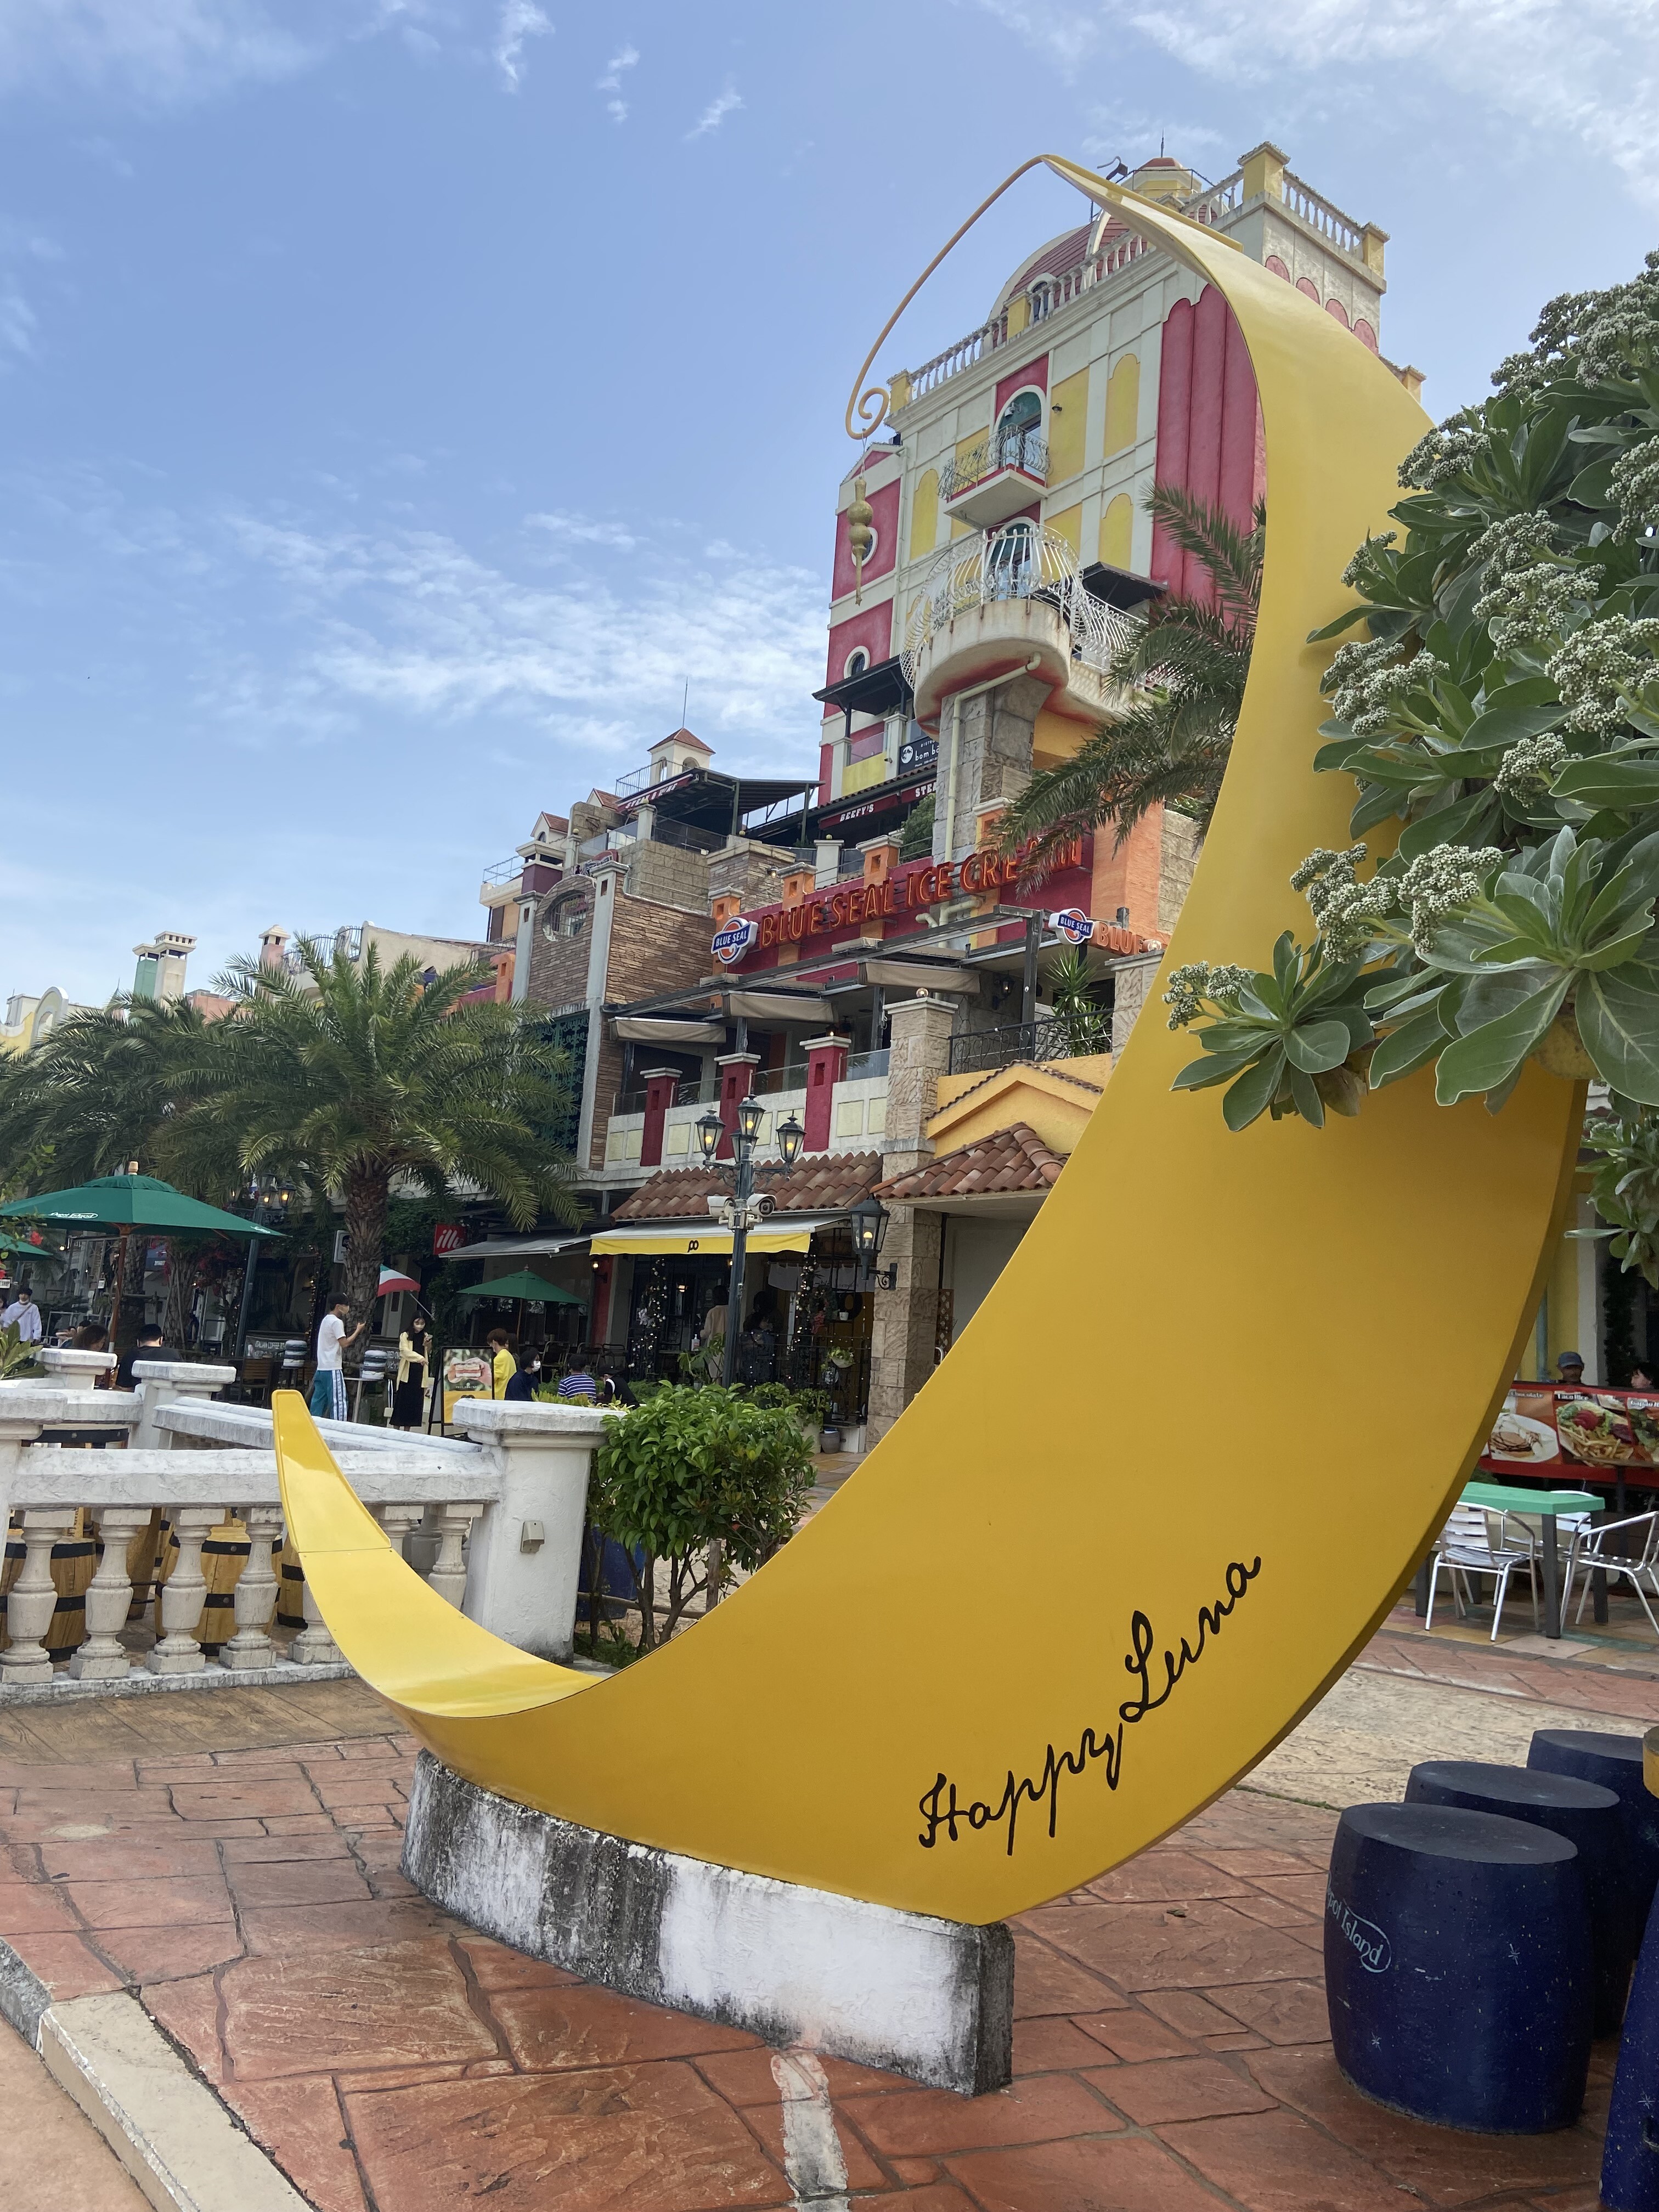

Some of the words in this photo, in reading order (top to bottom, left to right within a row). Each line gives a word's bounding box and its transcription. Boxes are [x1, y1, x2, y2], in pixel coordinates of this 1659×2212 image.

[915, 750, 929, 761] bom
[839, 804, 874, 822] BEEFY'S
[759, 900, 825, 950] BLUE
[829, 878, 896, 931] SEAL
[906, 861, 955, 908] ICE
[960, 832, 1082, 894] CREM
[1060, 916, 1075, 929] BLUE
[1076, 922, 1090, 934] SEAL
[1097, 921, 1144, 955] BLUE
[715, 936, 730, 947] BLUE
[732, 930, 747, 943] SEAL
[919, 1723, 1123, 1856] Happy
[1119, 1556, 1261, 1723] Luna
[1341, 1908, 1386, 1968] Island
